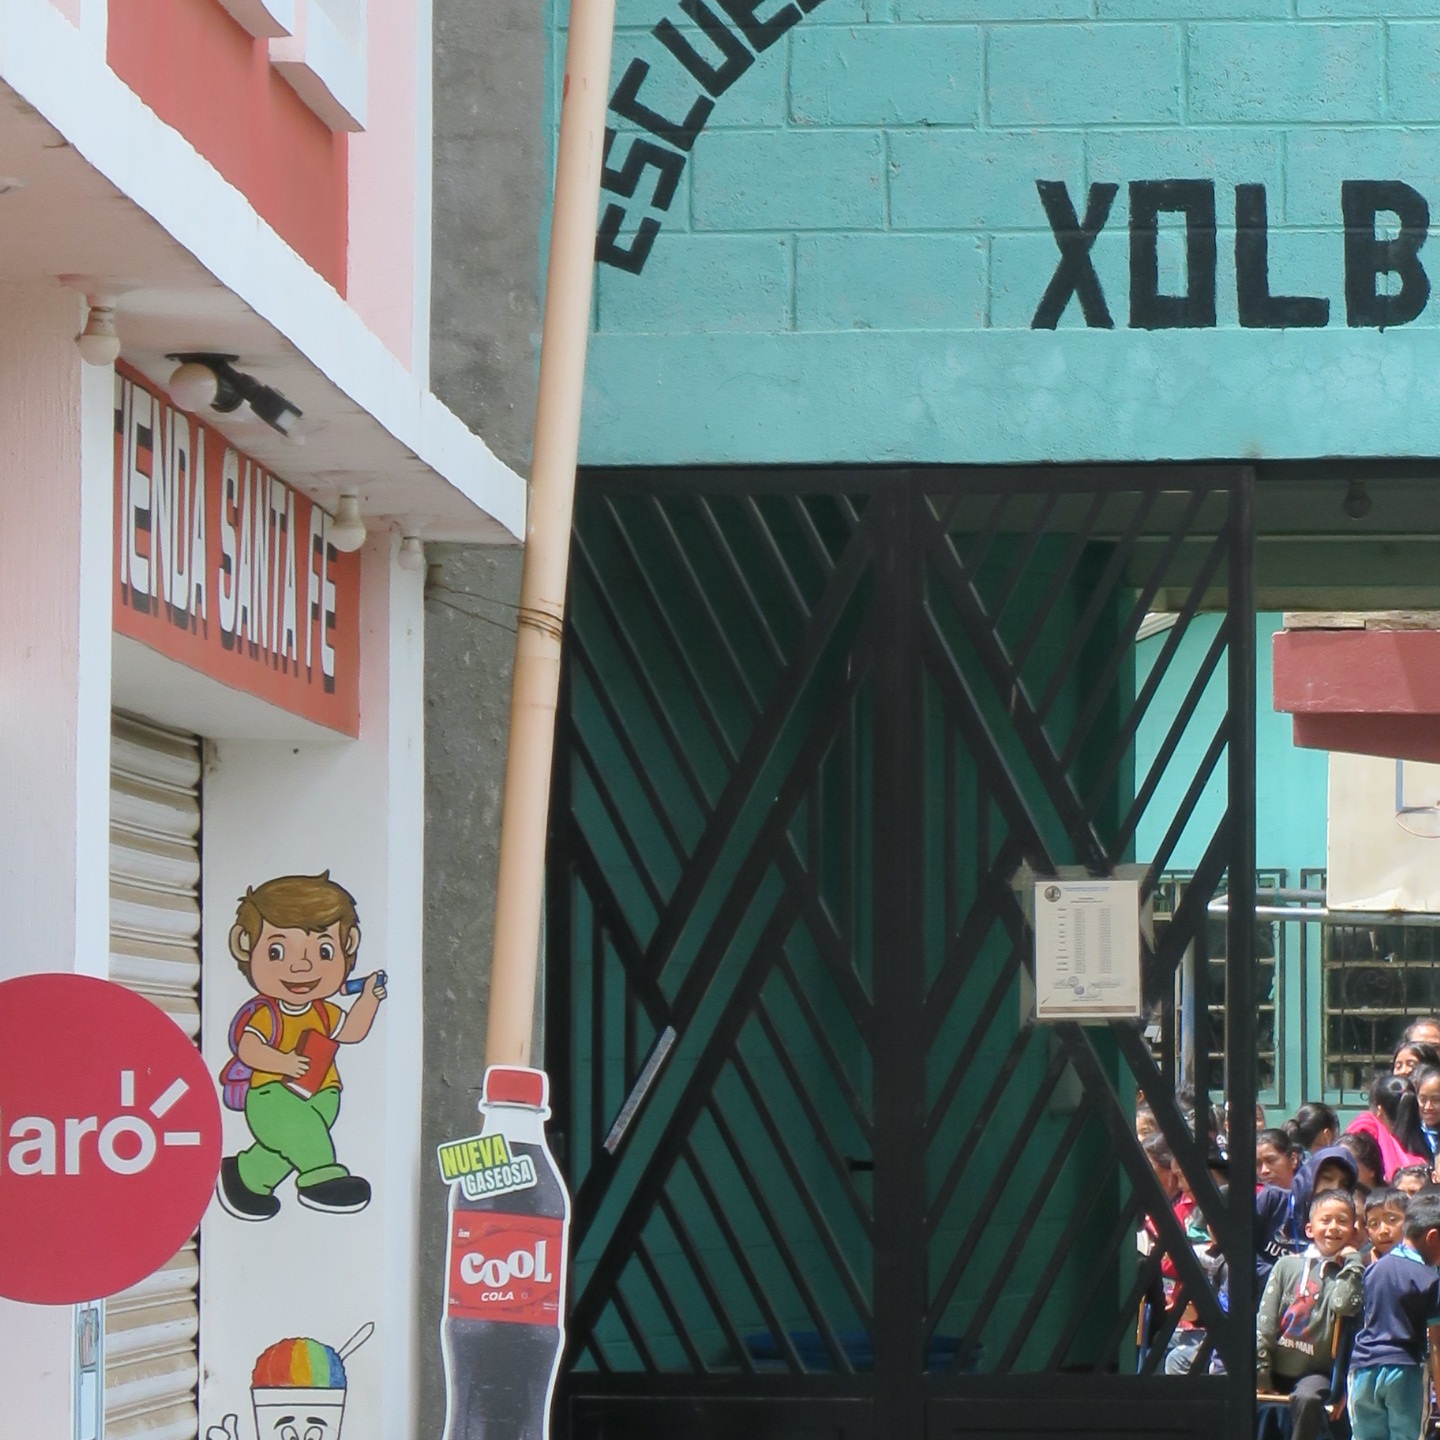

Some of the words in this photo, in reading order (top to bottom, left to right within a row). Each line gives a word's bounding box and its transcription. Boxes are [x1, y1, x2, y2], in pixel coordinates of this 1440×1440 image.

[114, 370, 207, 630] IENDA
[219, 446, 298, 668] SANTA
[306, 502, 337, 685] FE
[0, 1105, 158, 1176] aro
[441, 1135, 509, 1178] NUEVA
[465, 1160, 532, 1195] GASEOSA
[481, 1291, 515, 1302] COLA
